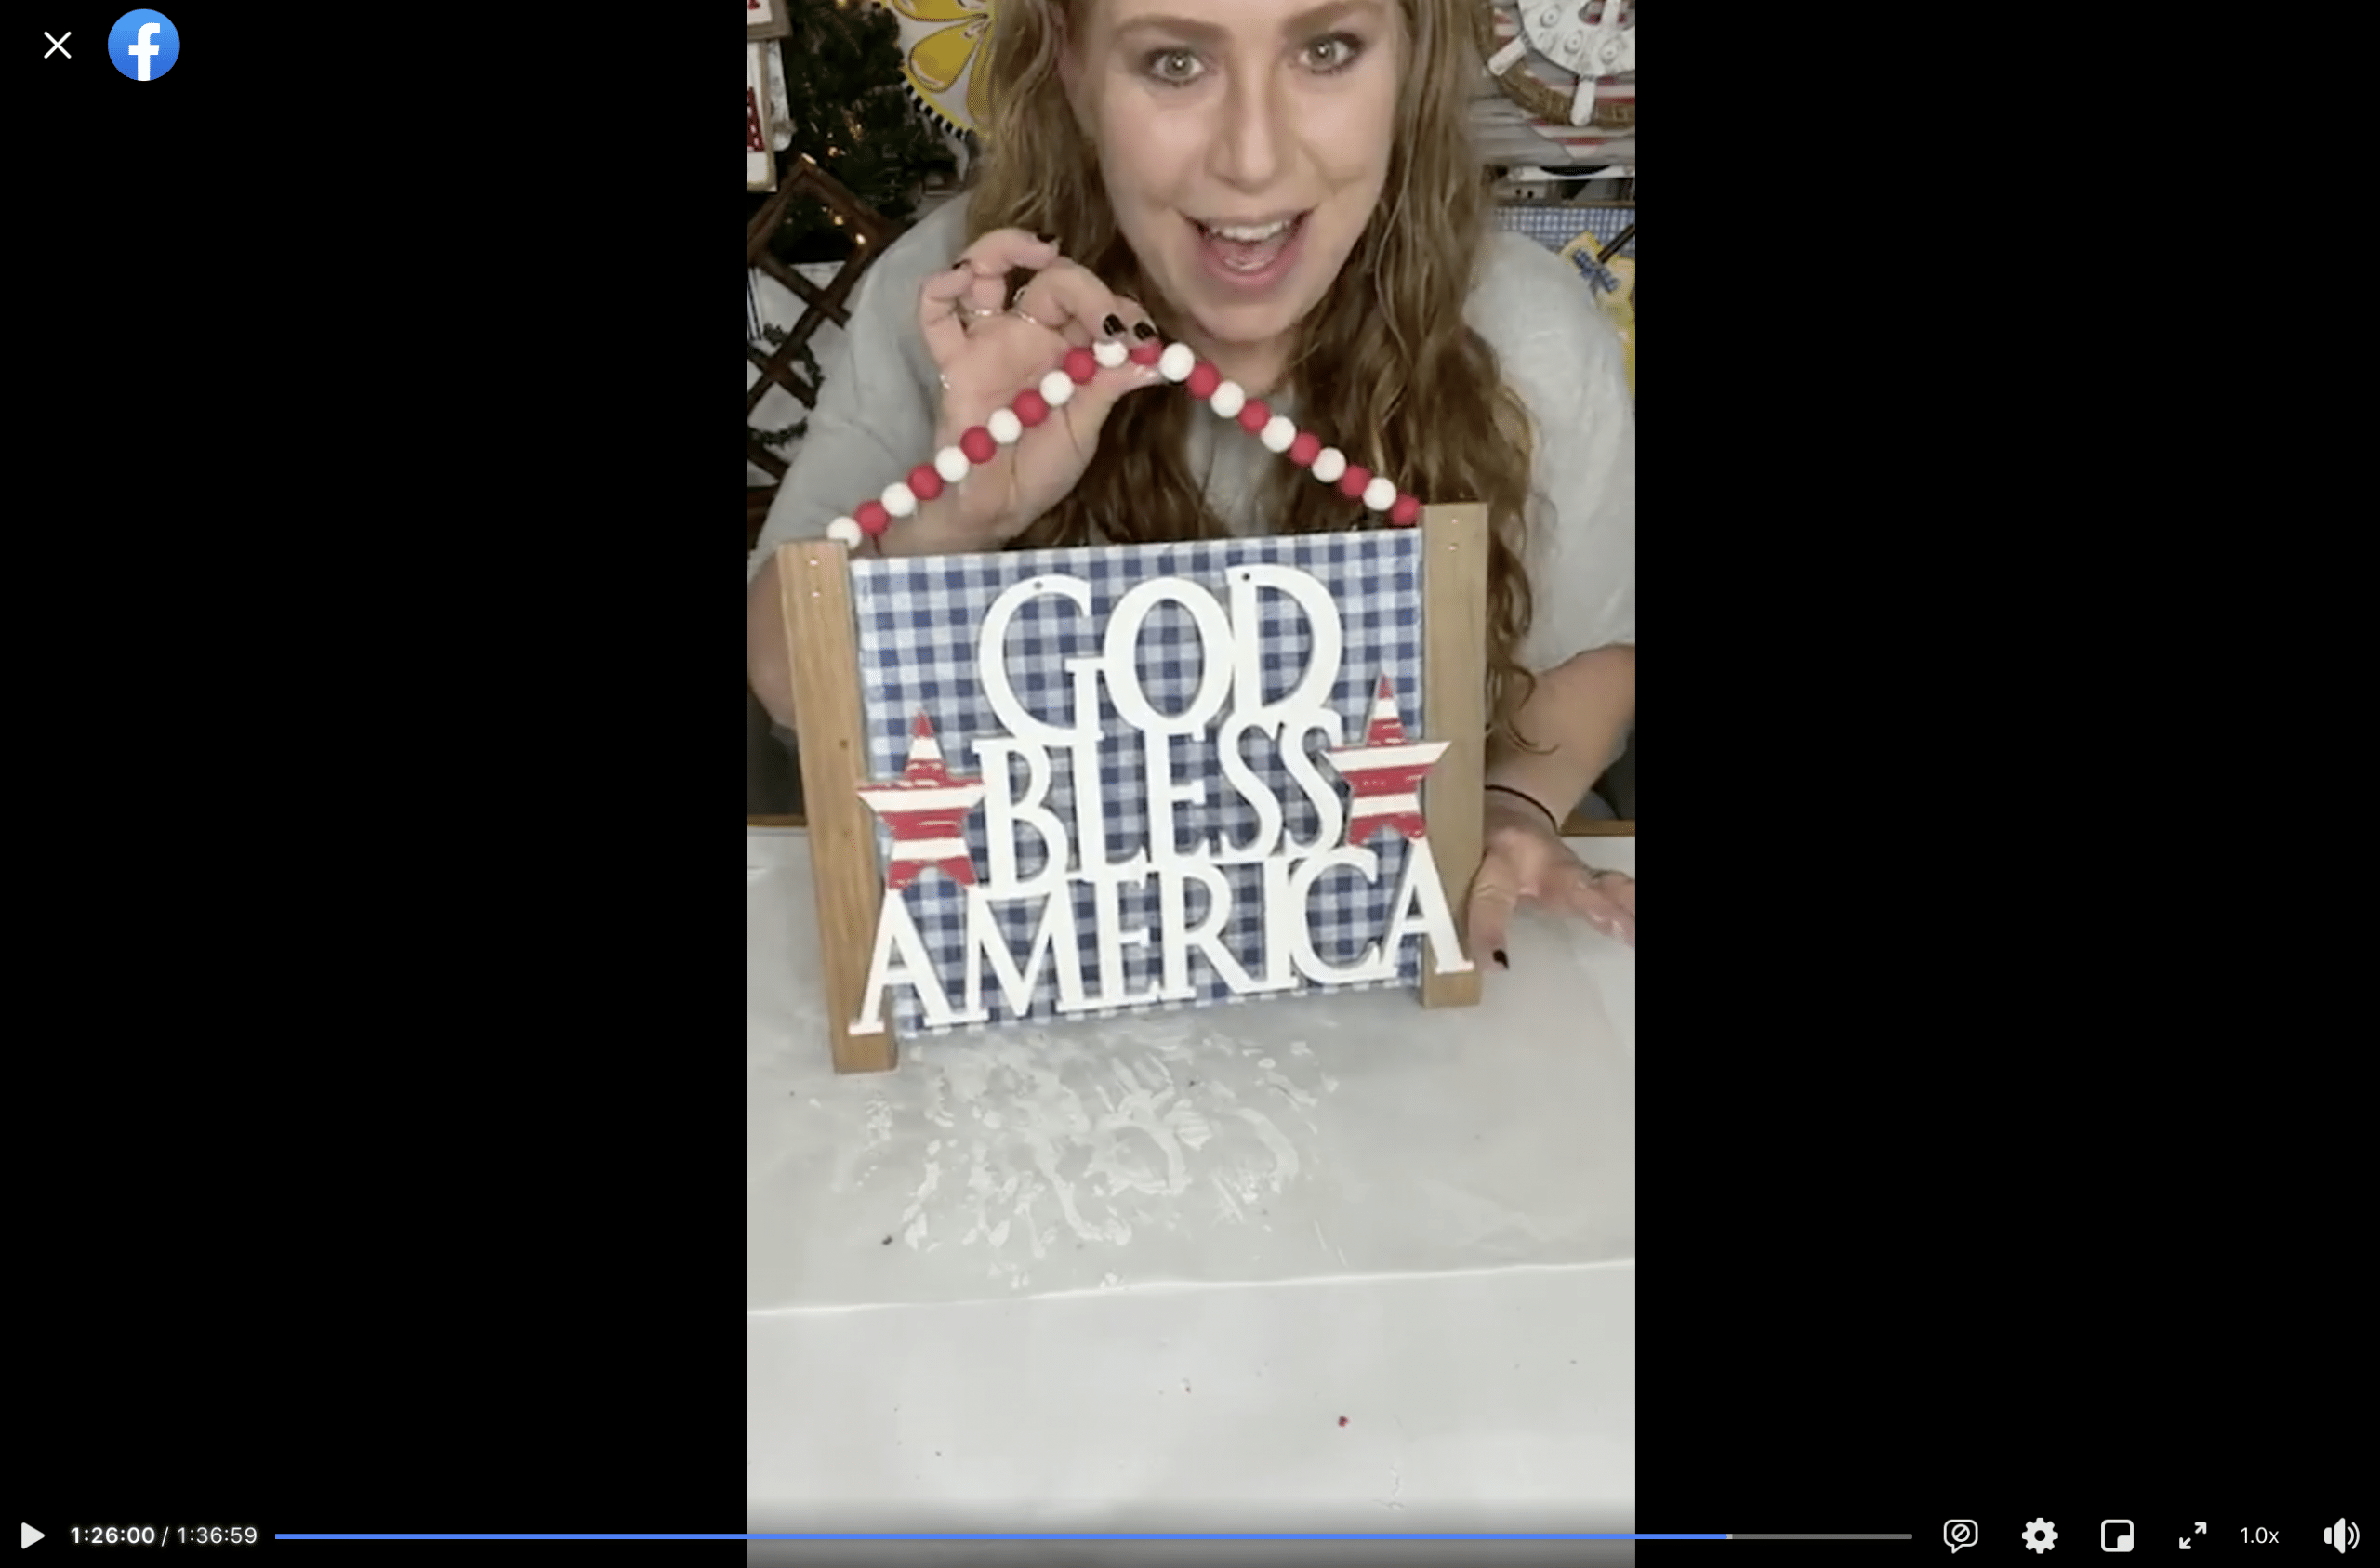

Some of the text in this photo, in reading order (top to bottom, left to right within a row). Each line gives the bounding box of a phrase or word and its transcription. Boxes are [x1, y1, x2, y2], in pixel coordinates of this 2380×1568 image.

[978, 565, 1343, 743] GOD
[972, 707, 1344, 899] BLESS
[848, 838, 1474, 1036] AMERICA
